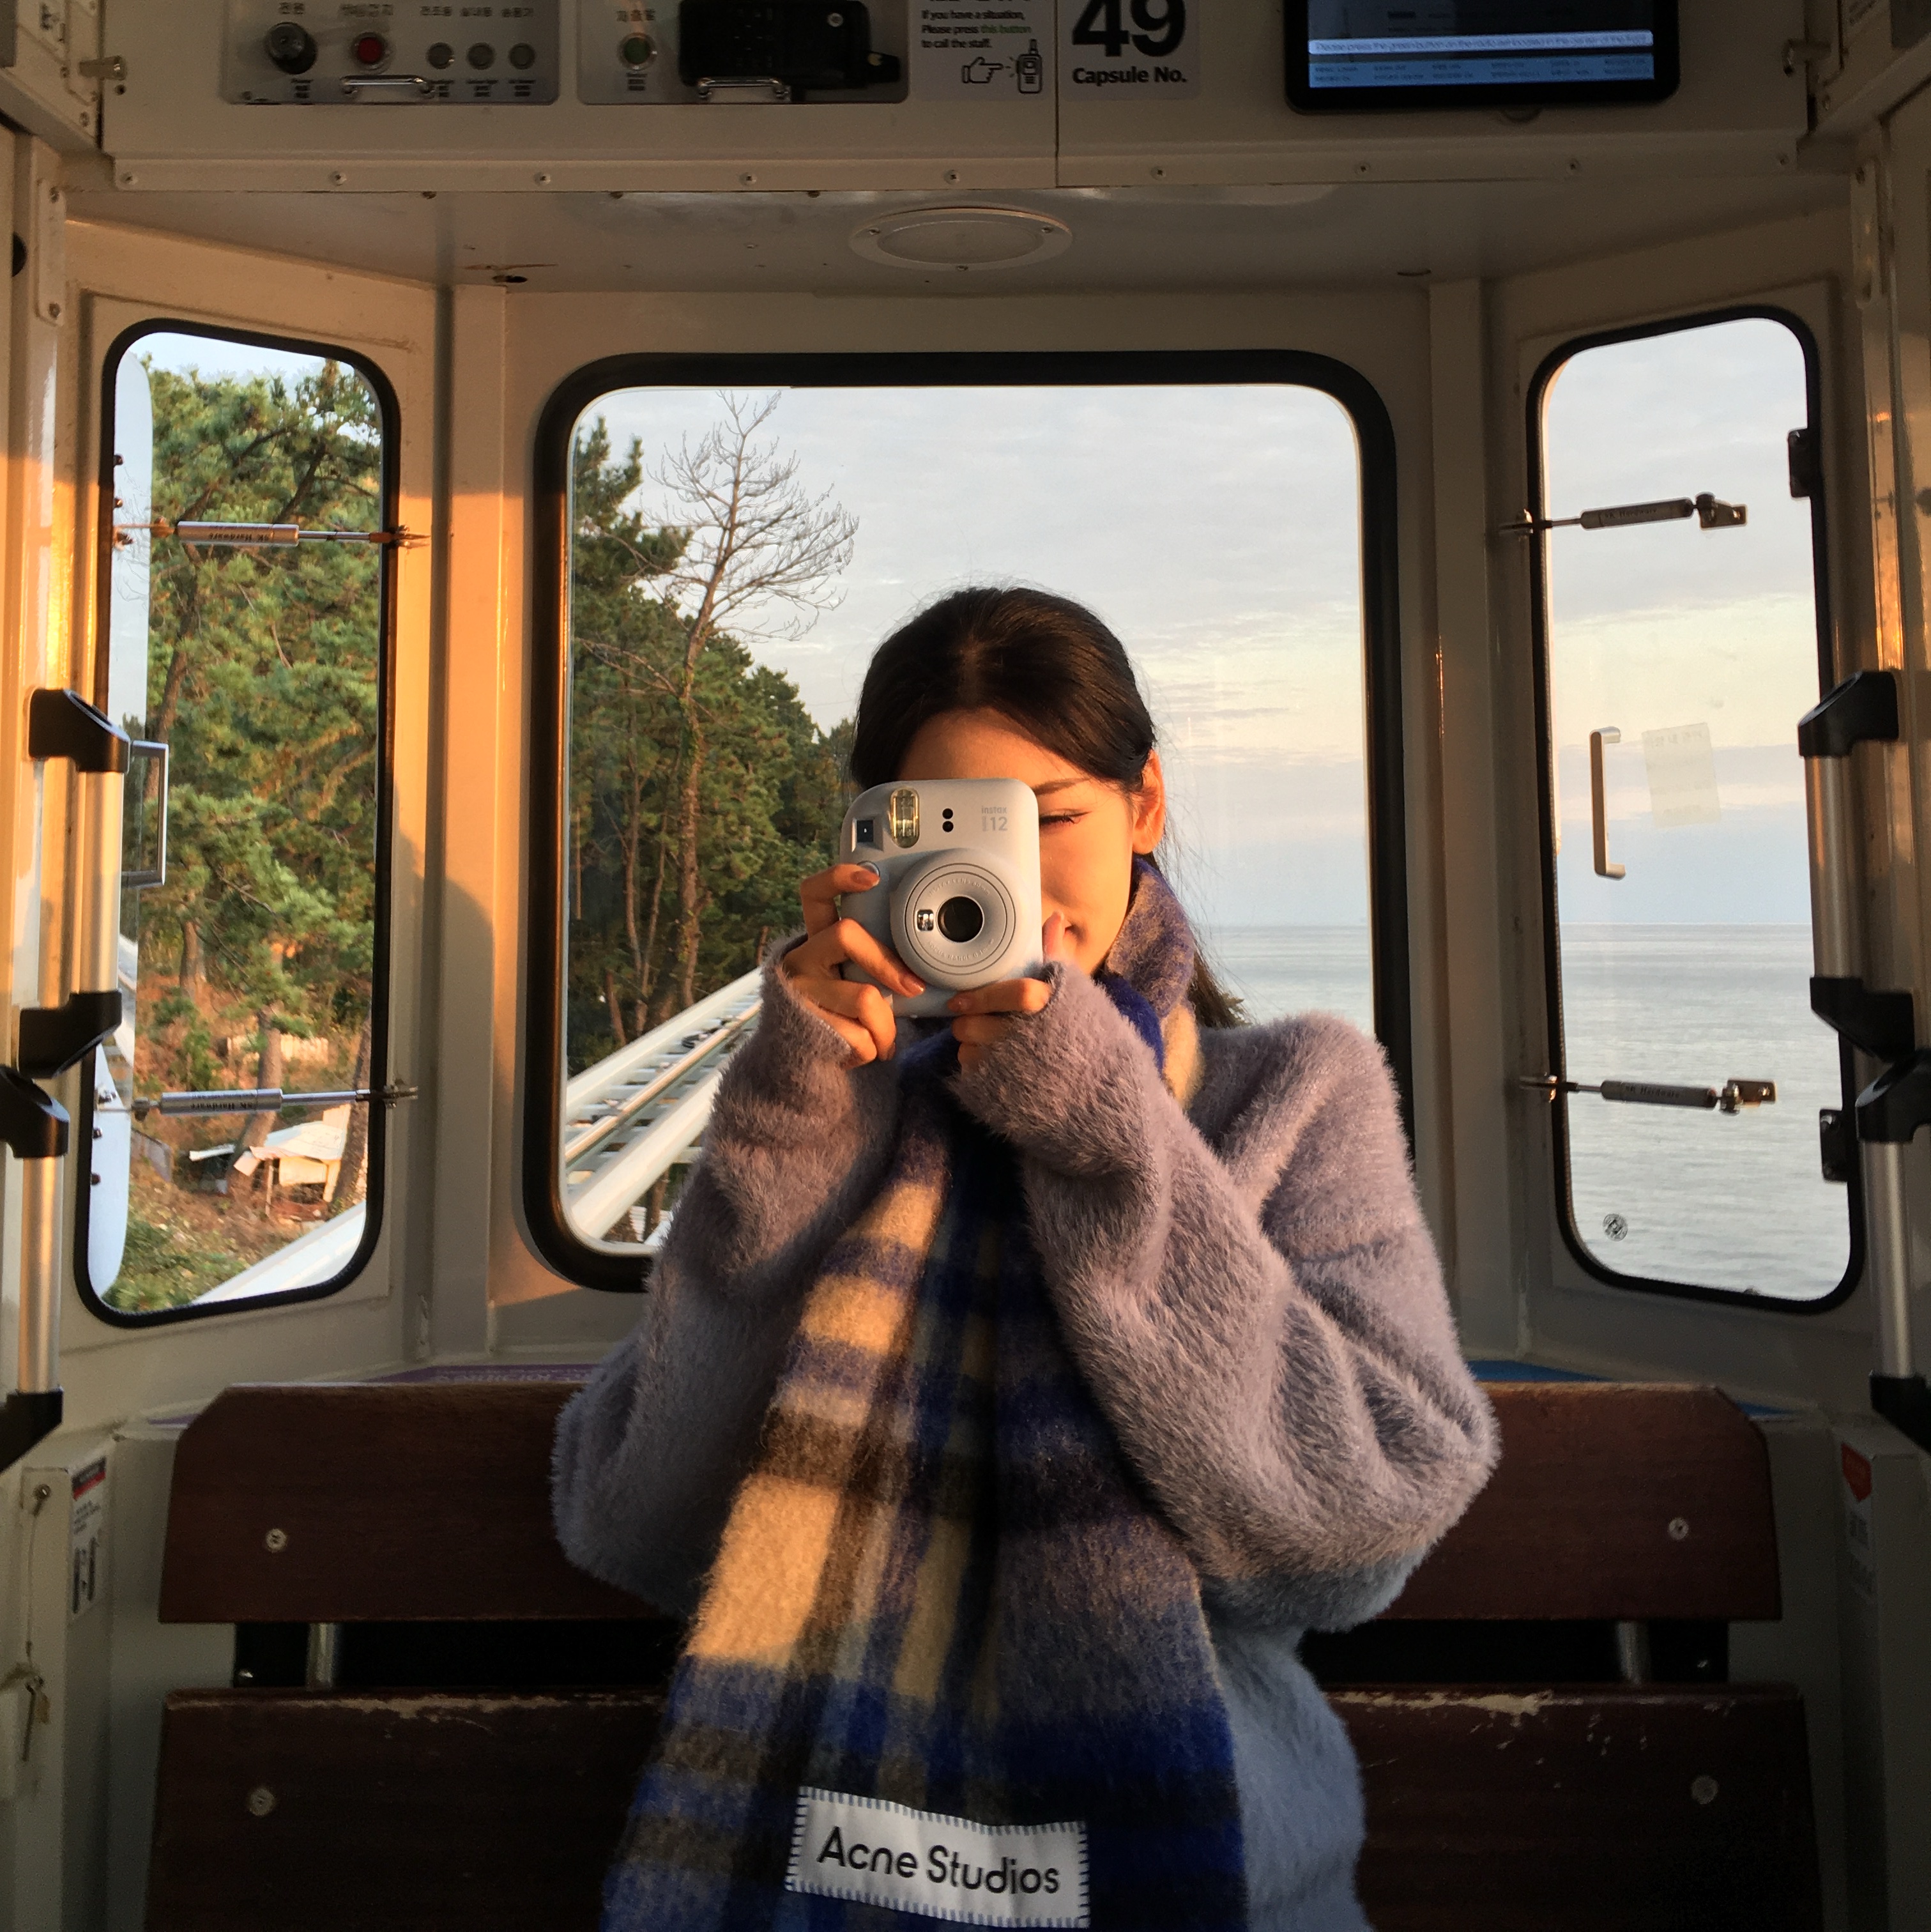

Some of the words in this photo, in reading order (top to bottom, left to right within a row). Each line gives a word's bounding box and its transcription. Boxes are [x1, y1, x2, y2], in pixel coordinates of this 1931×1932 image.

[921, 10, 929, 19] If
[930, 12, 948, 20] you
[950, 10, 973, 19] have
[921, 24, 951, 33] Please
[953, 26, 979, 34] press
[981, 24, 997, 33] this
[999, 24, 1032, 33] button
[1072, 0, 1186, 57] 49
[921, 39, 932, 47] to
[933, 38, 949, 47] call
[951, 38, 966, 47] the
[1072, 67, 1150, 86] Capsule
[1154, 66, 1187, 84] No.
[981, 805, 1007, 814] instax
[990, 816, 1008, 831] 12
[817, 1825, 919, 1878] Acne
[926, 1844, 1060, 1895] Studios
